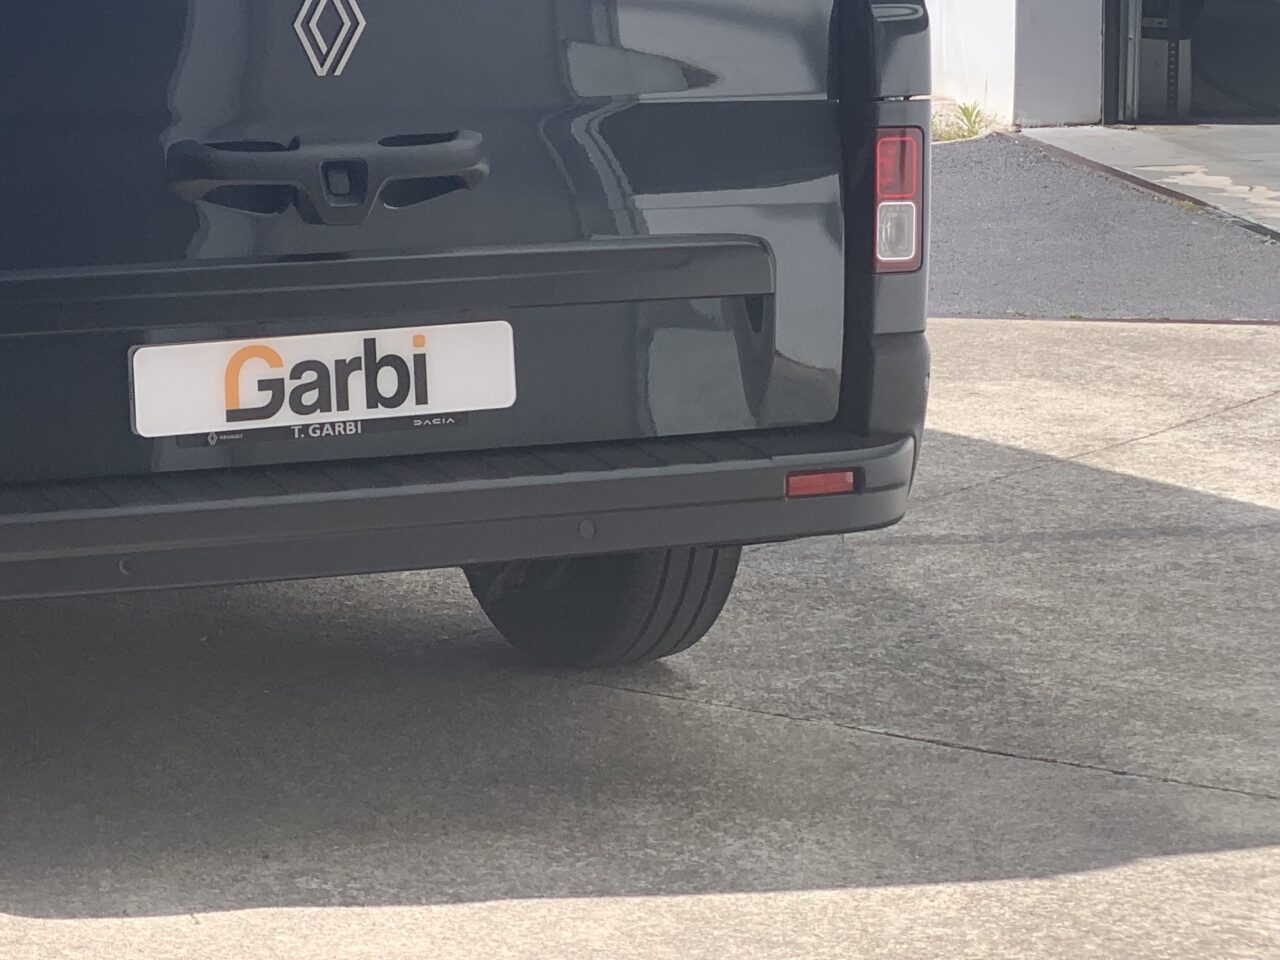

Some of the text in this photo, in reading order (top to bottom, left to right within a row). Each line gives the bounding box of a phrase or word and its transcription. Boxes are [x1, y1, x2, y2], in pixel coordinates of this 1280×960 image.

[224, 334, 429, 422] Garbi
[291, 421, 362, 438] T. GARBI
[413, 417, 455, 426] DACIA
